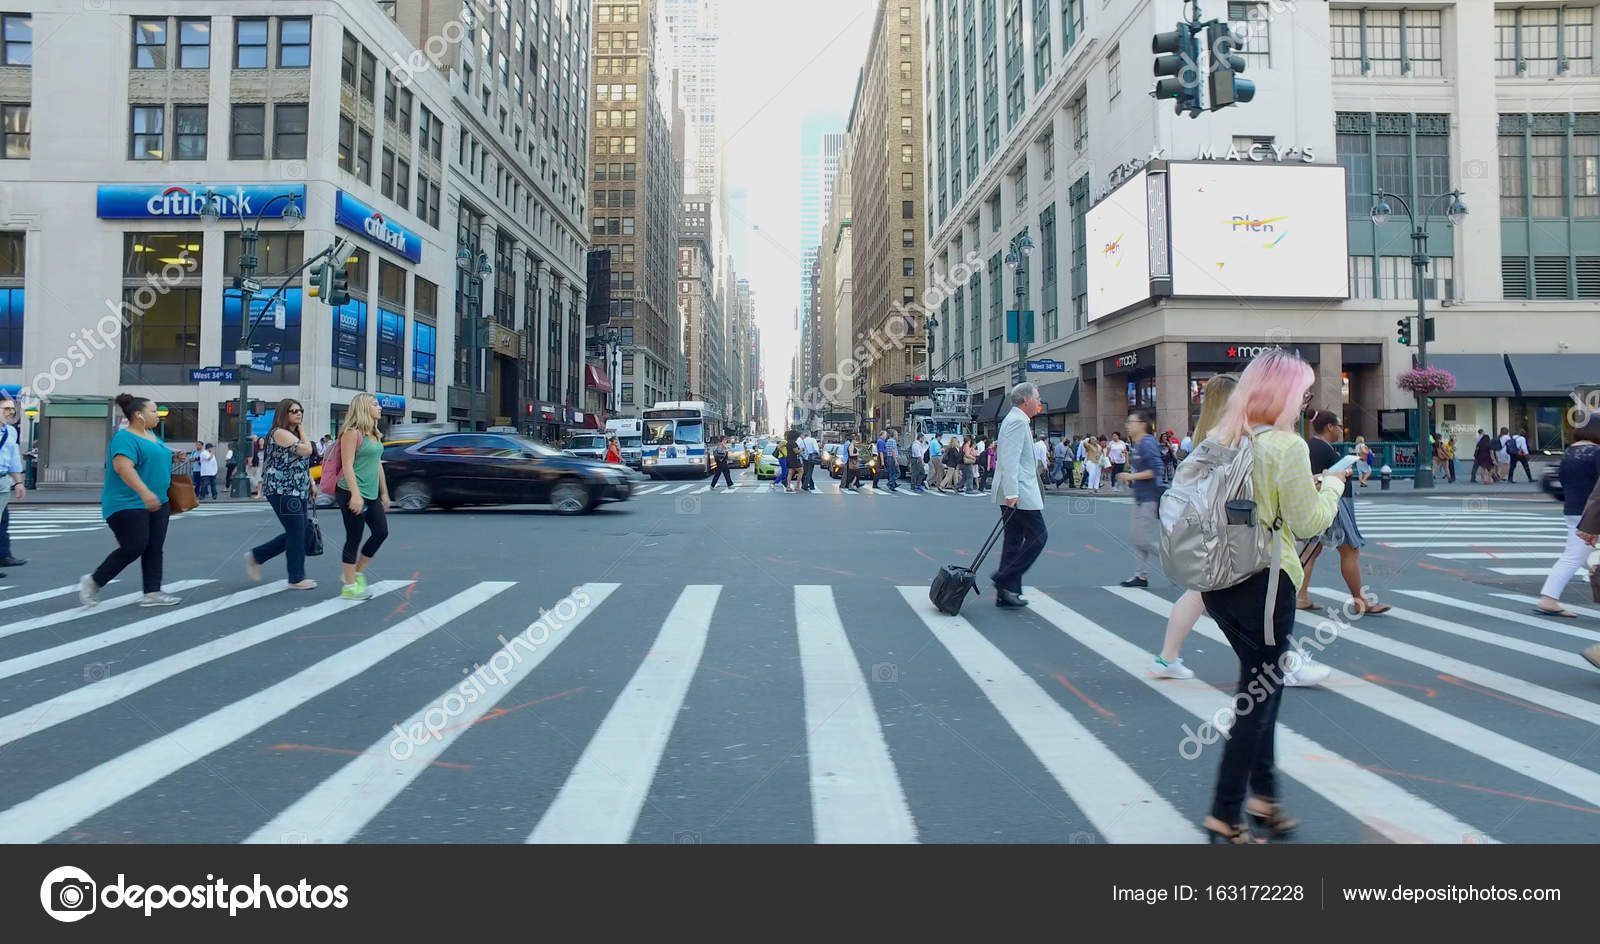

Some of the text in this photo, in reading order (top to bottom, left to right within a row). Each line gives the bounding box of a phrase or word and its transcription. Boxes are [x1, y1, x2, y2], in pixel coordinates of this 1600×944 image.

[1199, 143, 1315, 163] MACY'S
[365, 215, 406, 252] citibank
[193, 371, 210, 379] West
[225, 371, 232, 380] St
